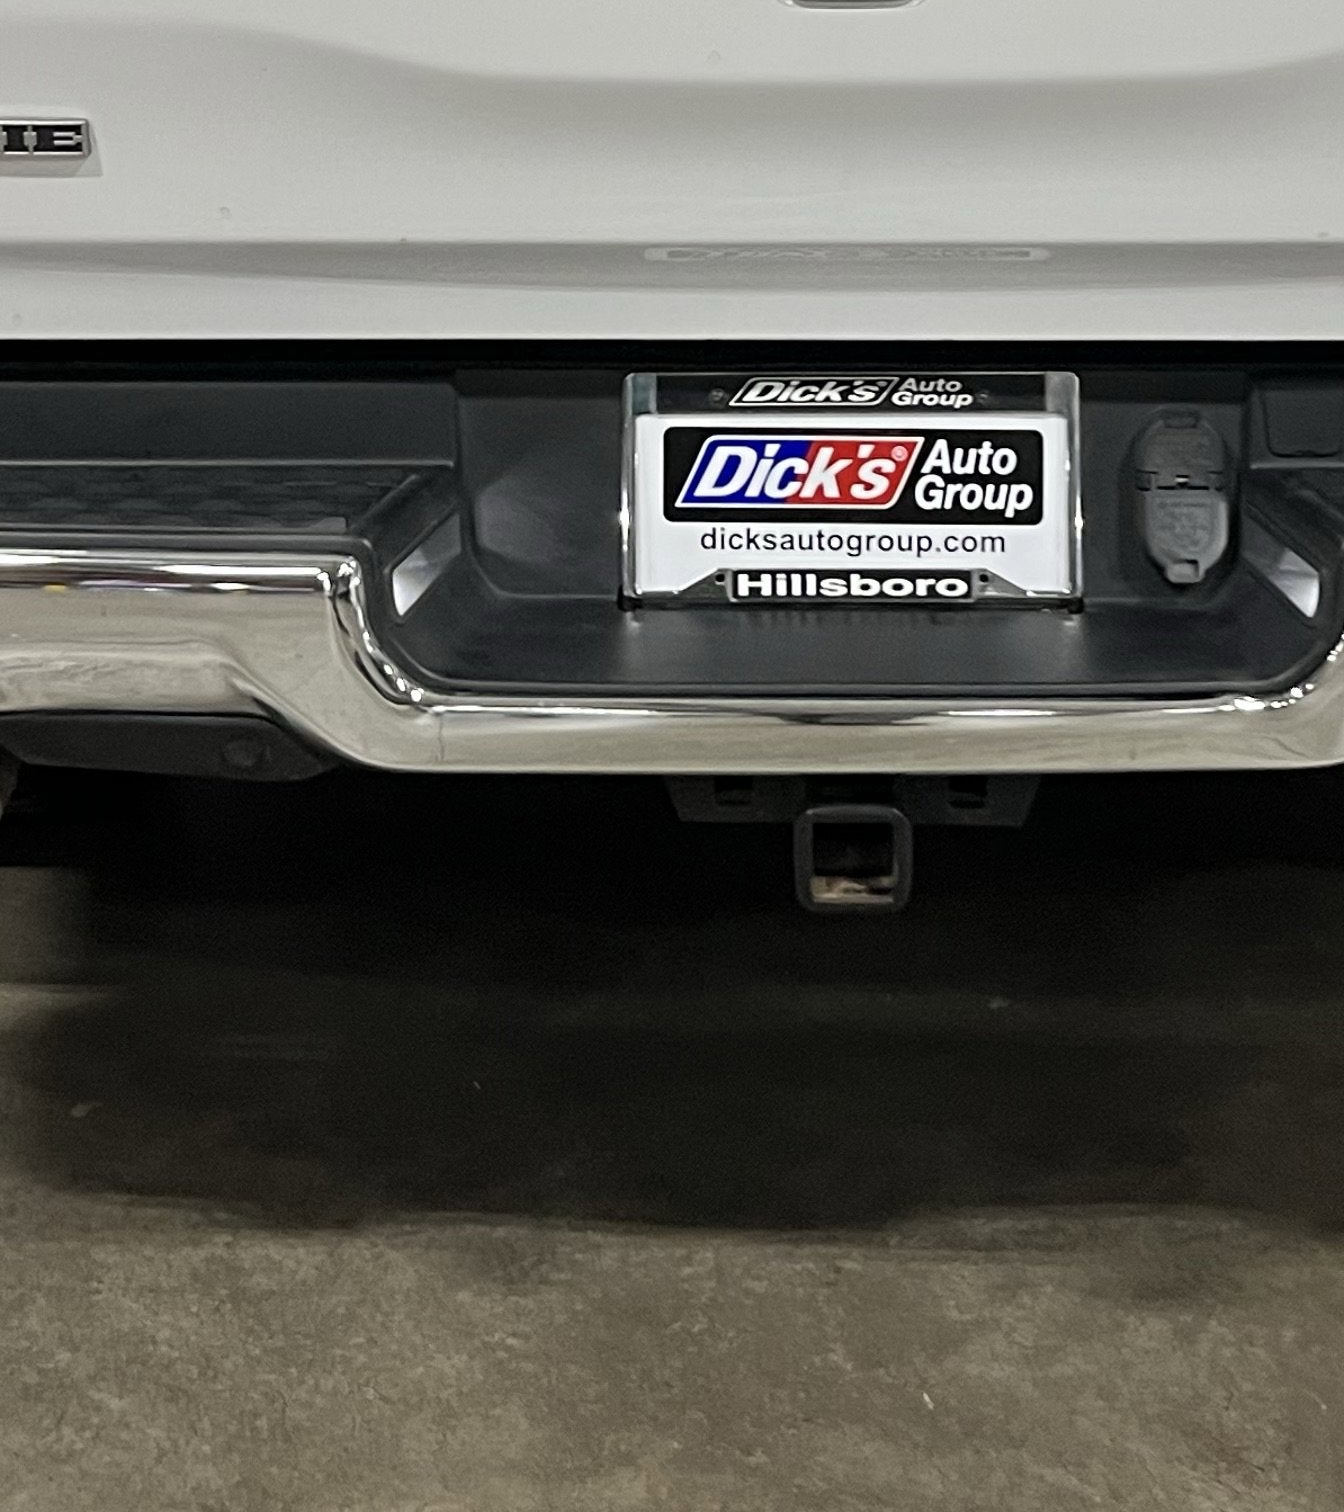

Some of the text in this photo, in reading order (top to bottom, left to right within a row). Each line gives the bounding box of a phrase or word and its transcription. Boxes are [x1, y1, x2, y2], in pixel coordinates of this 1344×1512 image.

[742, 380, 880, 402] Dick's
[898, 377, 963, 392] Auto
[891, 391, 973, 408] Group
[693, 440, 896, 500] Dick's
[920, 439, 1018, 476] Auto
[914, 474, 1034, 518] Group
[700, 526, 1006, 557] dicksautogroup.com
[737, 572, 969, 598] Hillsboro
